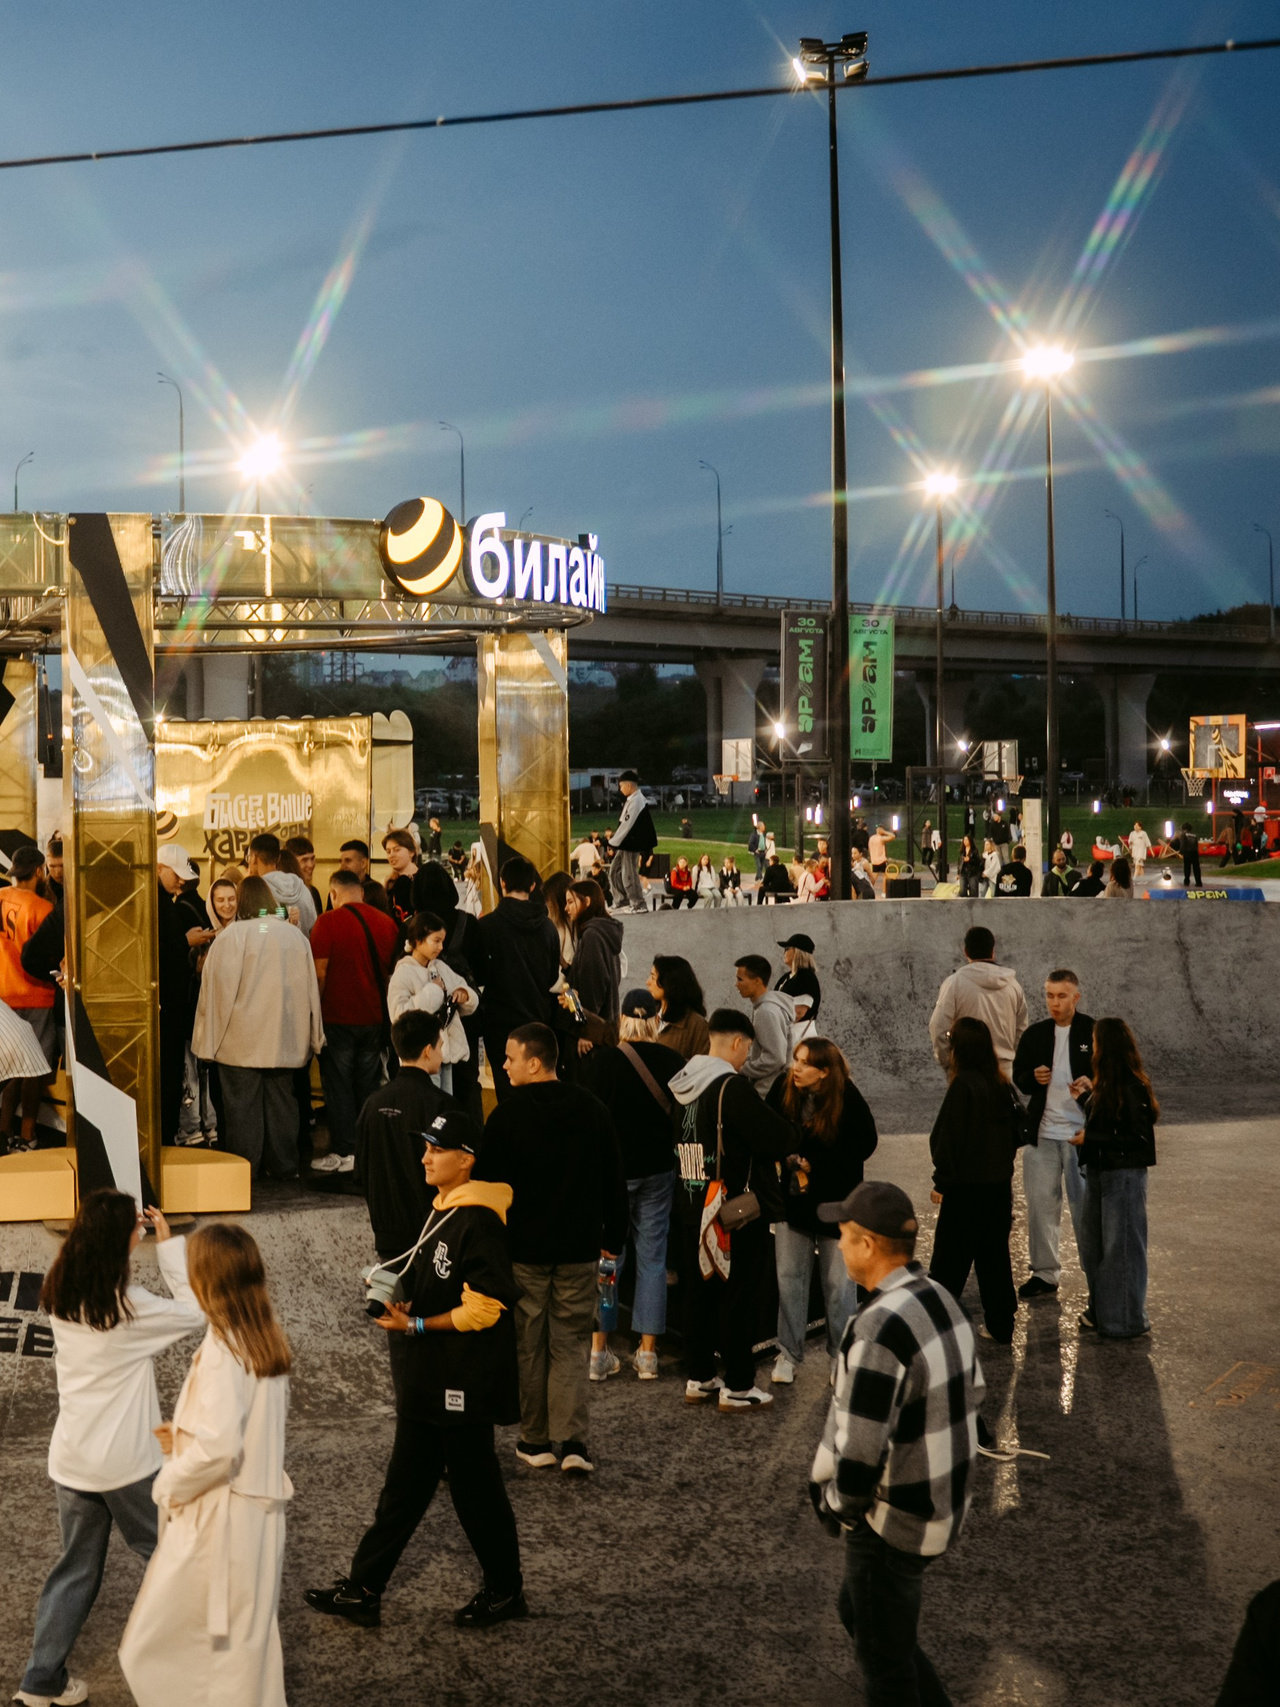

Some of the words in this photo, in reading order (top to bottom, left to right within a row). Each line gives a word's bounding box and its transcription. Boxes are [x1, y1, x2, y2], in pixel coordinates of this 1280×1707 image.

[469, 511, 607, 614] билайн
[797, 617, 816, 626] 30
[862, 619, 880, 627] 30
[788, 626, 824, 634] АВГУСТА
